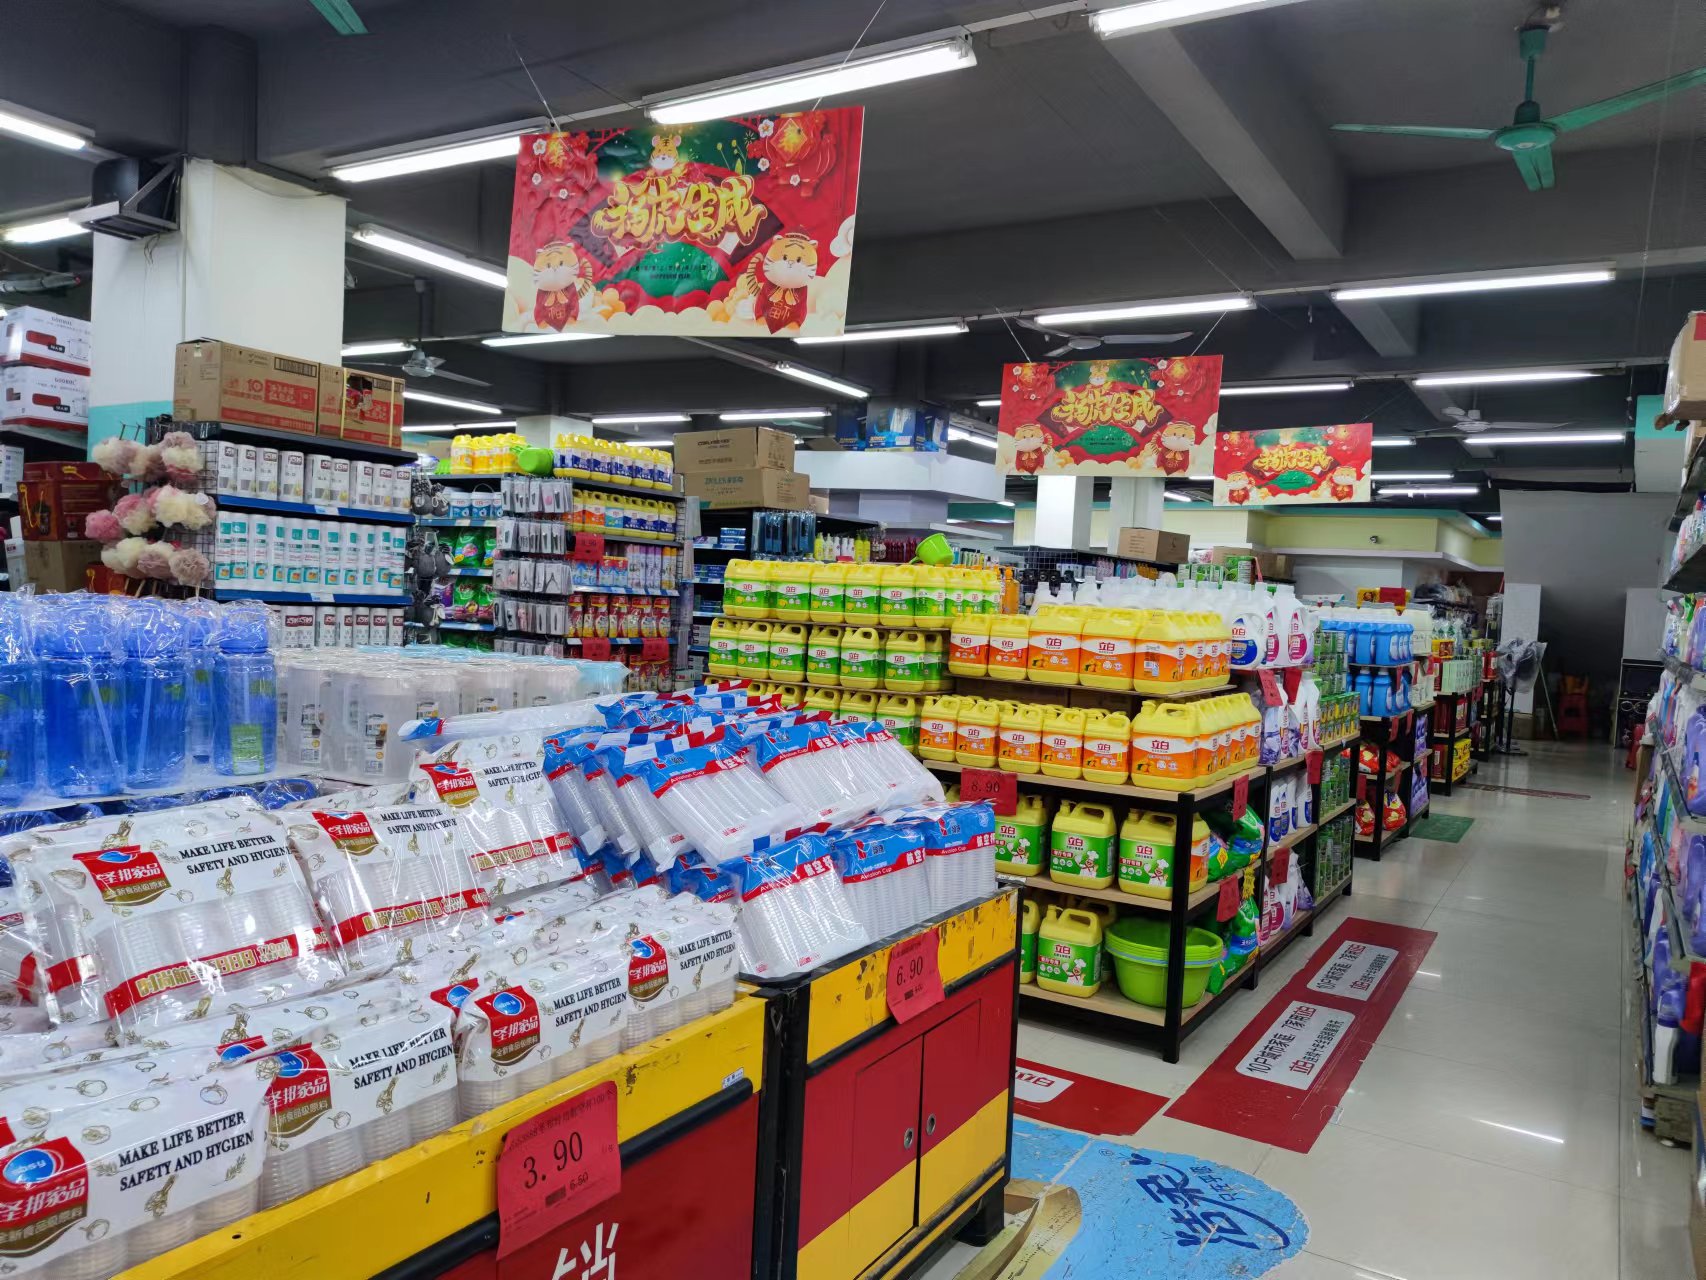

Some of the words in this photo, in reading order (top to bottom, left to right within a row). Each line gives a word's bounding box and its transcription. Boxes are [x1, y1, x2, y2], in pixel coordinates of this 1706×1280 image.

[960, 636, 972, 644] 立白
[1002, 640, 1014, 648] 立白
[1046, 638, 1062, 647] 立白
[1099, 642, 1115, 652] 立白
[932, 723, 943, 731] 立白
[968, 728, 980, 737] 立白
[1012, 734, 1025, 742] 立白
[1054, 738, 1066, 746] 立白
[1097, 743, 1111, 751] 立白
[1152, 739, 1169, 750] 立白
[693, 770, 705, 778] Cup
[487, 777, 511, 788] SAFETY
[380, 811, 401, 821] MAKE
[401, 811, 417, 820] LIFE
[387, 823, 411, 834] SAFETY
[413, 823, 427, 833] AND
[1000, 825, 1016, 835] 立白
[179, 844, 213, 860] MAKE
[213, 841, 237, 855] LIFE
[239, 835, 275, 850] BETTER
[1068, 837, 1084, 847] 立白
[1136, 845, 1153, 856] 立白
[187, 861, 221, 875] SAFETY
[222, 853, 249, 867] AND
[860, 869, 882, 880] Aviation
[882, 866, 892, 875] Cup
[679, 943, 696, 955] MAKE
[697, 937, 711, 949] LIFE
[1055, 944, 1071, 954] 立白
[680, 957, 701, 970] SAFETY
[702, 951, 715, 962] AND
[896, 956, 923, 986] 6.90
[553, 997, 576, 1010] MAKE
[576, 988, 593, 1002] LIFE
[594, 977, 622, 997] BETTER
[555, 1009, 583, 1027] SAFETY
[583, 1003, 599, 1017] AND
[493, 1016, 538, 1041] 圣邦家品
[381, 1041, 405, 1058] LIFE
[354, 1067, 394, 1089] SAFETY
[395, 1058, 417, 1075] AND
[118, 1141, 160, 1168] MAKE
[162, 1129, 194, 1151] LIFE
[196, 1111, 246, 1139] BETTER
[523, 1131, 583, 1189] 3.90
[120, 1161, 172, 1191] SAFETY
[174, 1150, 203, 1172] AND
